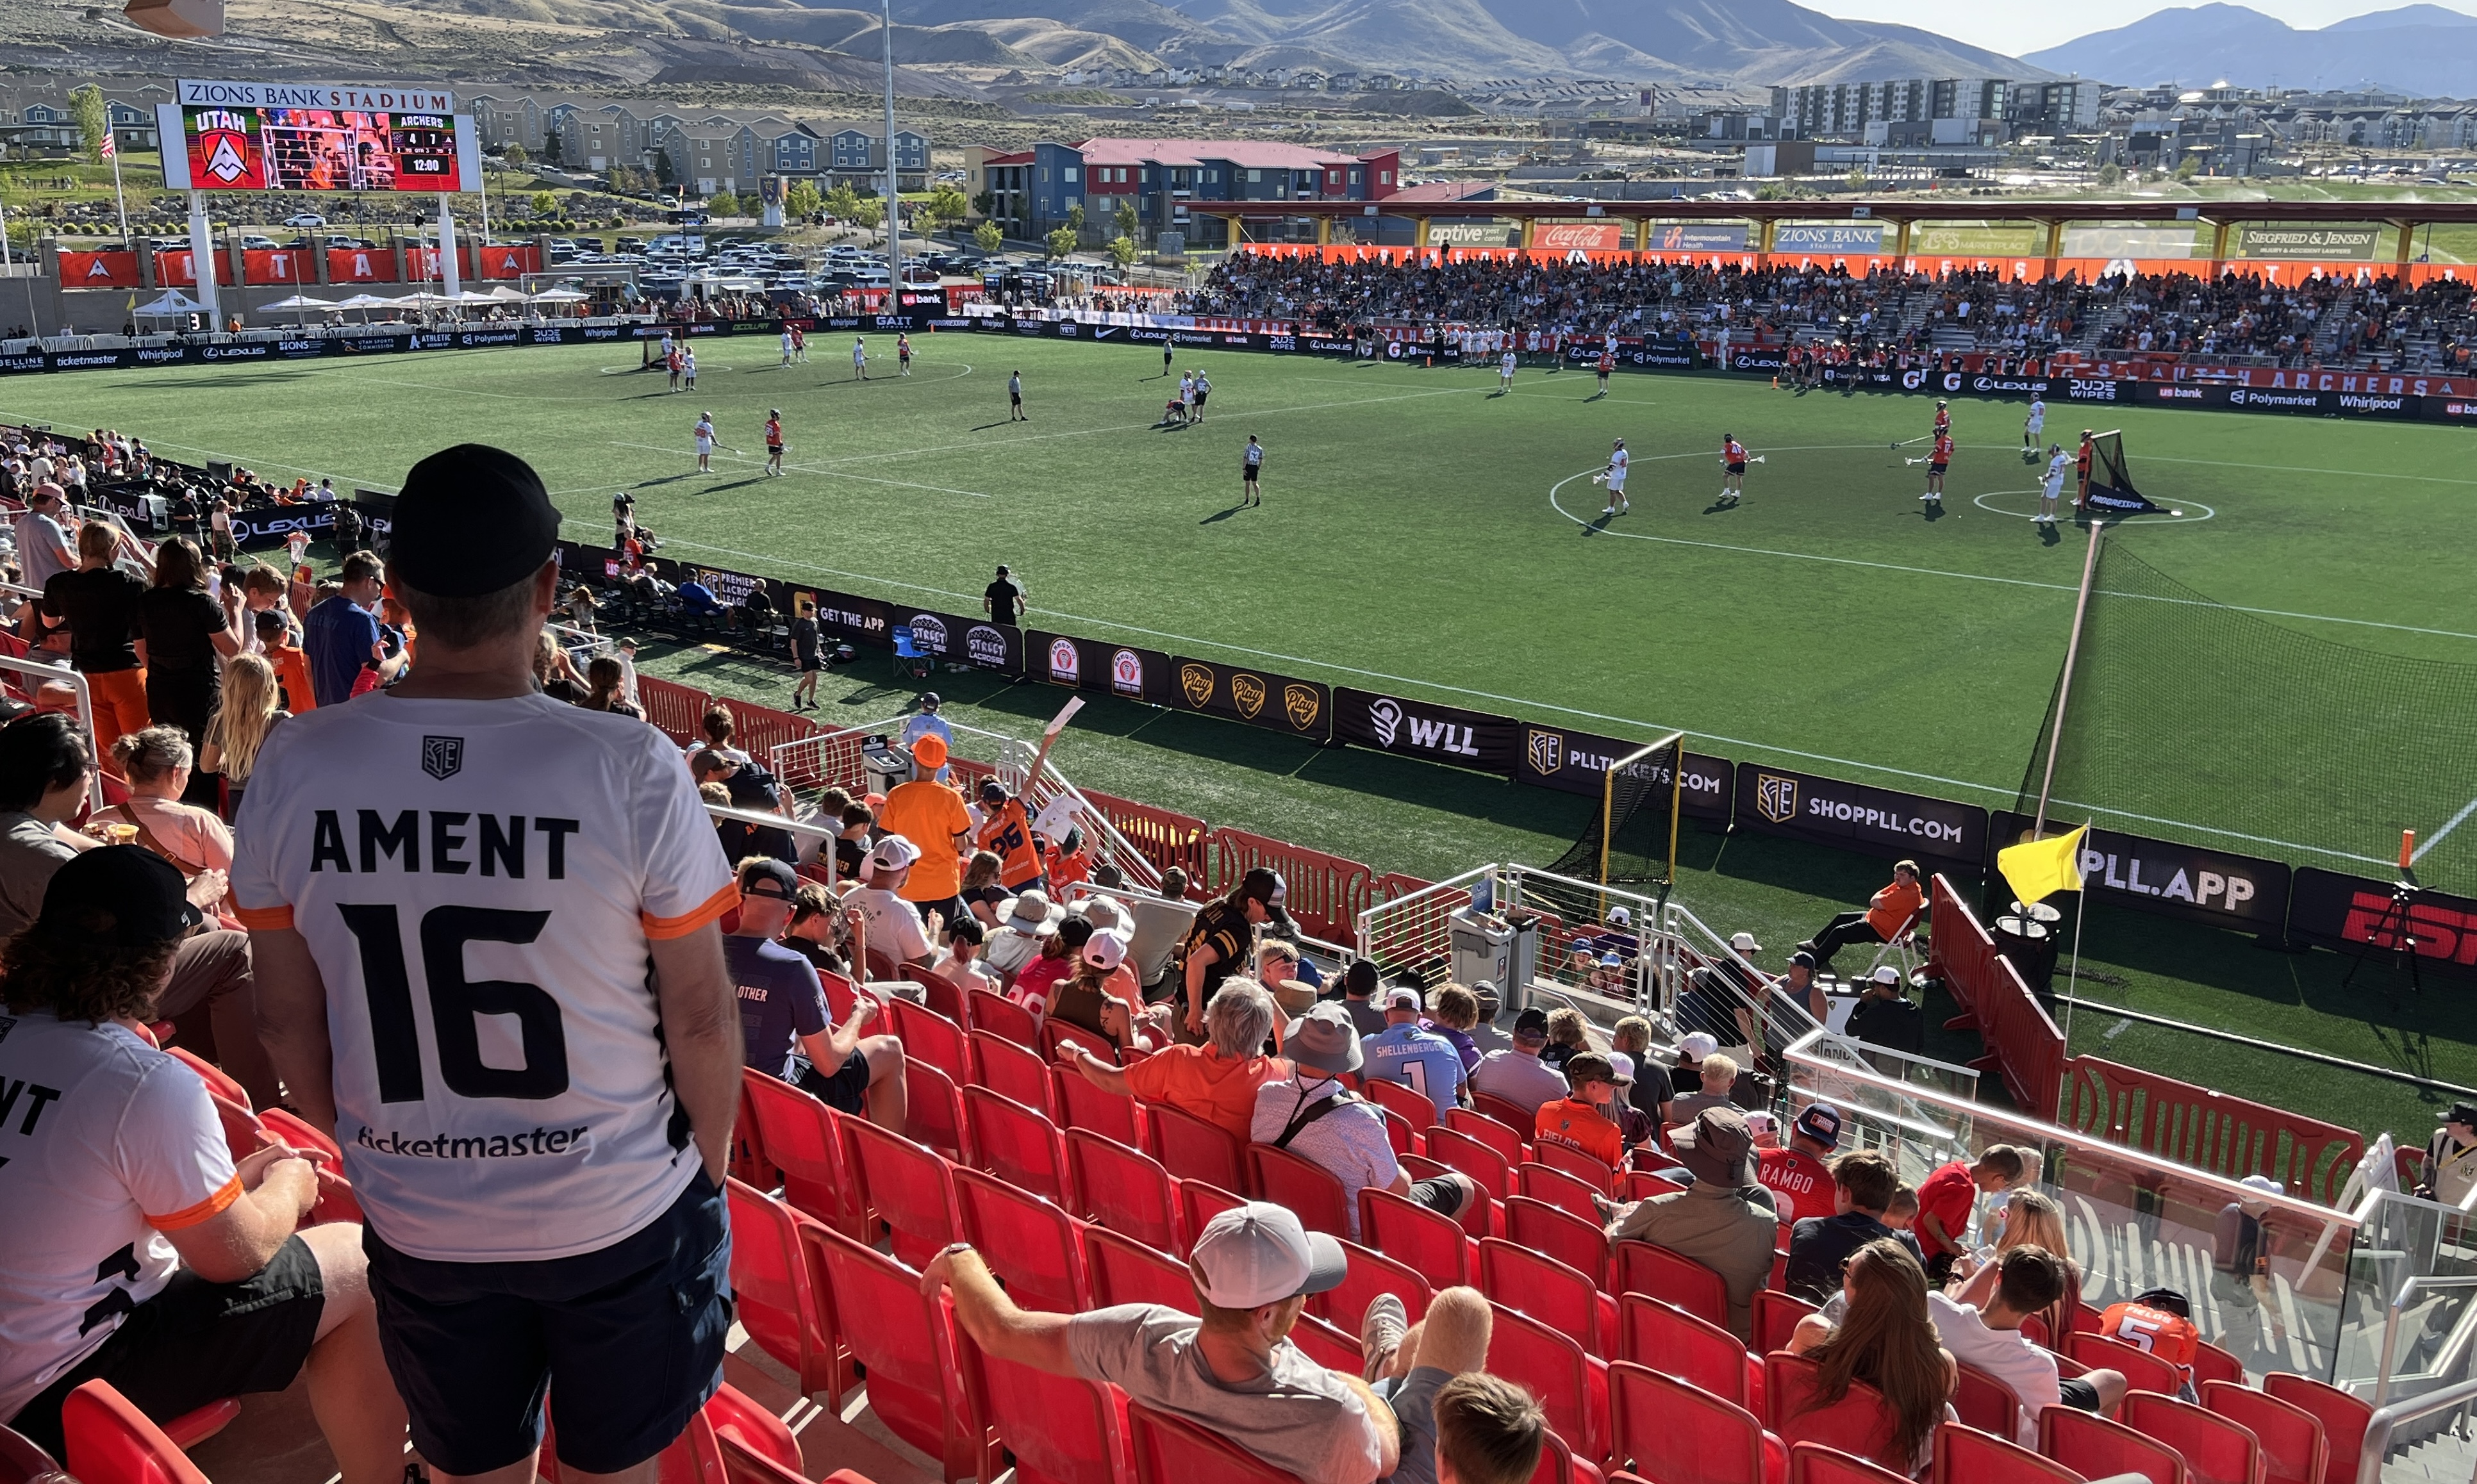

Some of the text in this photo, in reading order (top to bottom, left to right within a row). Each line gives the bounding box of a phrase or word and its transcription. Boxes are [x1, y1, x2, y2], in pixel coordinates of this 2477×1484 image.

[187, 84, 446, 110] ZIONS BANK STADIUM
[195, 110, 246, 133] UTAH
[401, 116, 443, 128] ARCHERS
[410, 133, 417, 144] 4
[430, 133, 436, 144] 7
[413, 159, 439, 171] 12:00
[1430, 224, 1482, 246] aptive
[1779, 229, 1876, 243] ZIONS BANK
[2247, 231, 2370, 245] SIEGFRIED & JENSEN
[1960, 241, 2027, 251] MARKETPLACE
[902, 293, 941, 304] us bank
[191, 313, 200, 330] 3
[830, 317, 857, 328] Whirlpool
[981, 319, 1004, 330] Whirlpool
[1061, 326, 1075, 334] YETI
[1210, 320, 1250, 333] UTAH
[422, 334, 451, 342] ATHLETIC
[474, 333, 517, 343] Polymarket
[584, 328, 618, 340] Whirlpool
[1182, 334, 1211, 343] Polymarket
[138, 349, 183, 361] Whirlpool
[220, 347, 266, 356] LEXUS
[1646, 355, 1689, 365] Polymarket
[56, 355, 118, 367] ticketmaster
[1944, 373, 1960, 391] G
[1993, 381, 2047, 392] LEXUS
[2070, 381, 2116, 391] DUDE
[2271, 372, 2428, 396] ARCHERS
[2071, 390, 2115, 400] WIPES
[2160, 387, 2203, 399] us bank
[2249, 393, 2316, 406] Polymarket
[2339, 395, 2401, 411] Whirlpool
[2447, 404, 2462, 413] us
[2090, 495, 2144, 509] PROGRESSIVE
[253, 515, 336, 534] LEXUS
[721, 573, 755, 587] PREMIER
[820, 606, 884, 632] GET THE APP
[913, 627, 946, 645] STREET
[970, 638, 1004, 657] STREET
[968, 651, 1005, 665] LACROSSE
[1184, 669, 1211, 699] Play
[1235, 679, 1263, 710] Play
[1288, 689, 1317, 721] Play
[1407, 715, 1479, 757] WLL
[446, 743, 456, 769] PLL
[1546, 736, 1558, 768] PLL
[1570, 750, 1719, 794] PLLTKETS.COM
[1780, 782, 1792, 815] PLL
[1809, 798, 1962, 844] SHOPPLL.COM
[309, 809, 580, 879] AMENT
[990, 821, 1024, 857] 26
[2080, 847, 2255, 911] PLL.APP
[843, 904, 875, 924] BREATHE
[738, 985, 768, 1002] OTHER
[335, 902, 568, 1103] 16
[1377, 1046, 1444, 1064] SHELLENBERGER
[1401, 1060, 1427, 1098] 1
[358, 1124, 587, 1159] ticketmaster
[1543, 1129, 1580, 1151] FIELDS
[1760, 1163, 1814, 1194] RAMBO
[2125, 1306, 2172, 1324] FIELDS
[2117, 1315, 2161, 1353] 5
